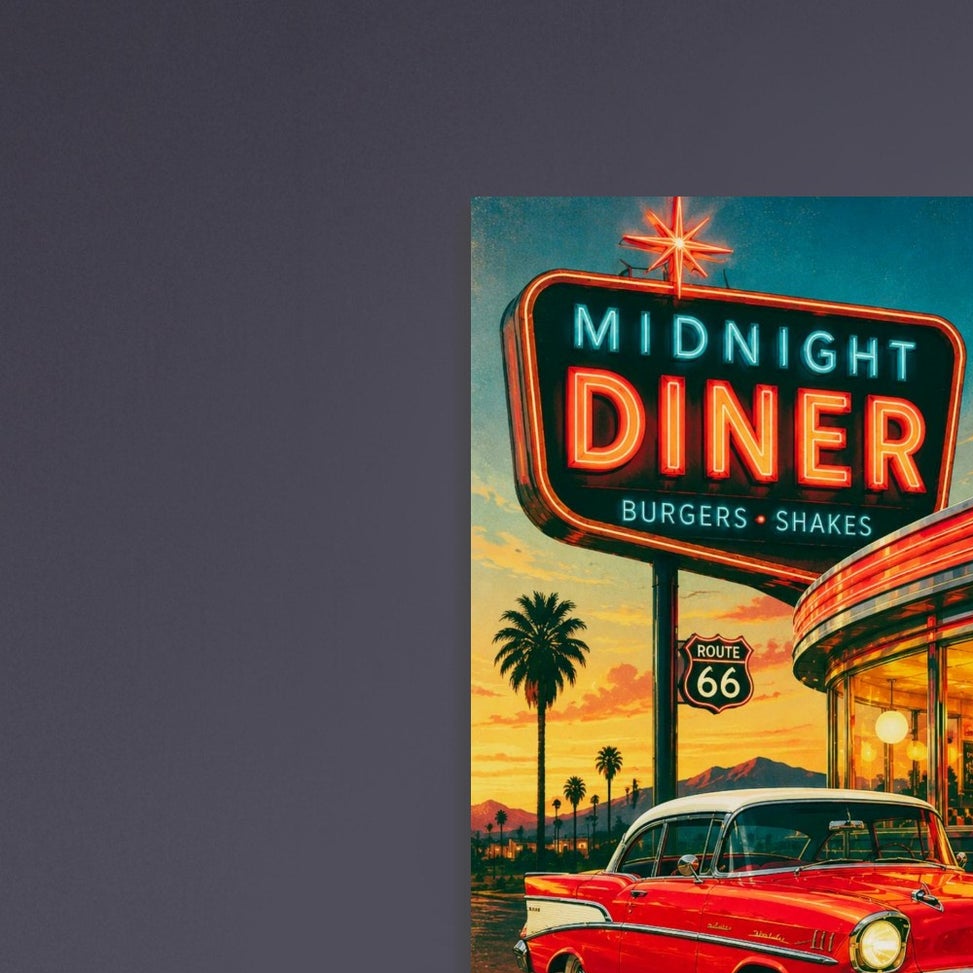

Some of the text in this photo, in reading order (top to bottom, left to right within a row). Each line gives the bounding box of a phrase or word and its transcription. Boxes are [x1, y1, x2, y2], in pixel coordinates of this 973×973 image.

[573, 303, 917, 382] MIDNIGHT
[566, 366, 928, 494] DINER
[621, 499, 874, 538] BURGERS SHAKES
[696, 643, 741, 660] ROUTE
[696, 666, 740, 699] 66
